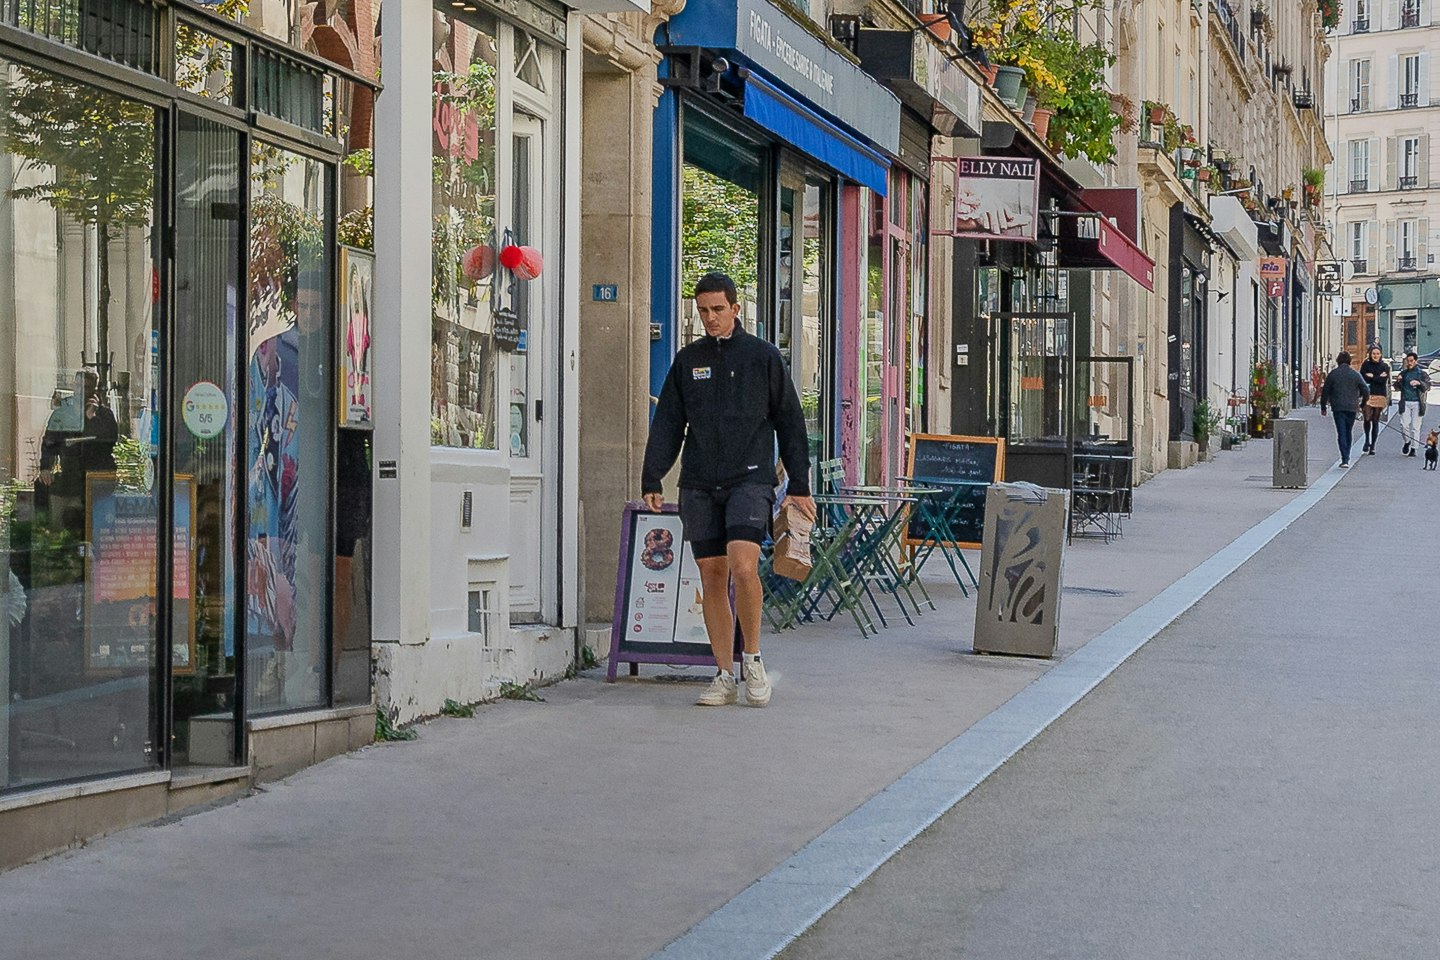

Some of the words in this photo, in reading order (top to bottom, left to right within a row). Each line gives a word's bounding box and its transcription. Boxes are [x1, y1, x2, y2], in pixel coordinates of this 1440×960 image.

[960, 160, 997, 176] ELLY
[1262, 261, 1280, 272] Ria
[600, 287, 612, 300] 16
